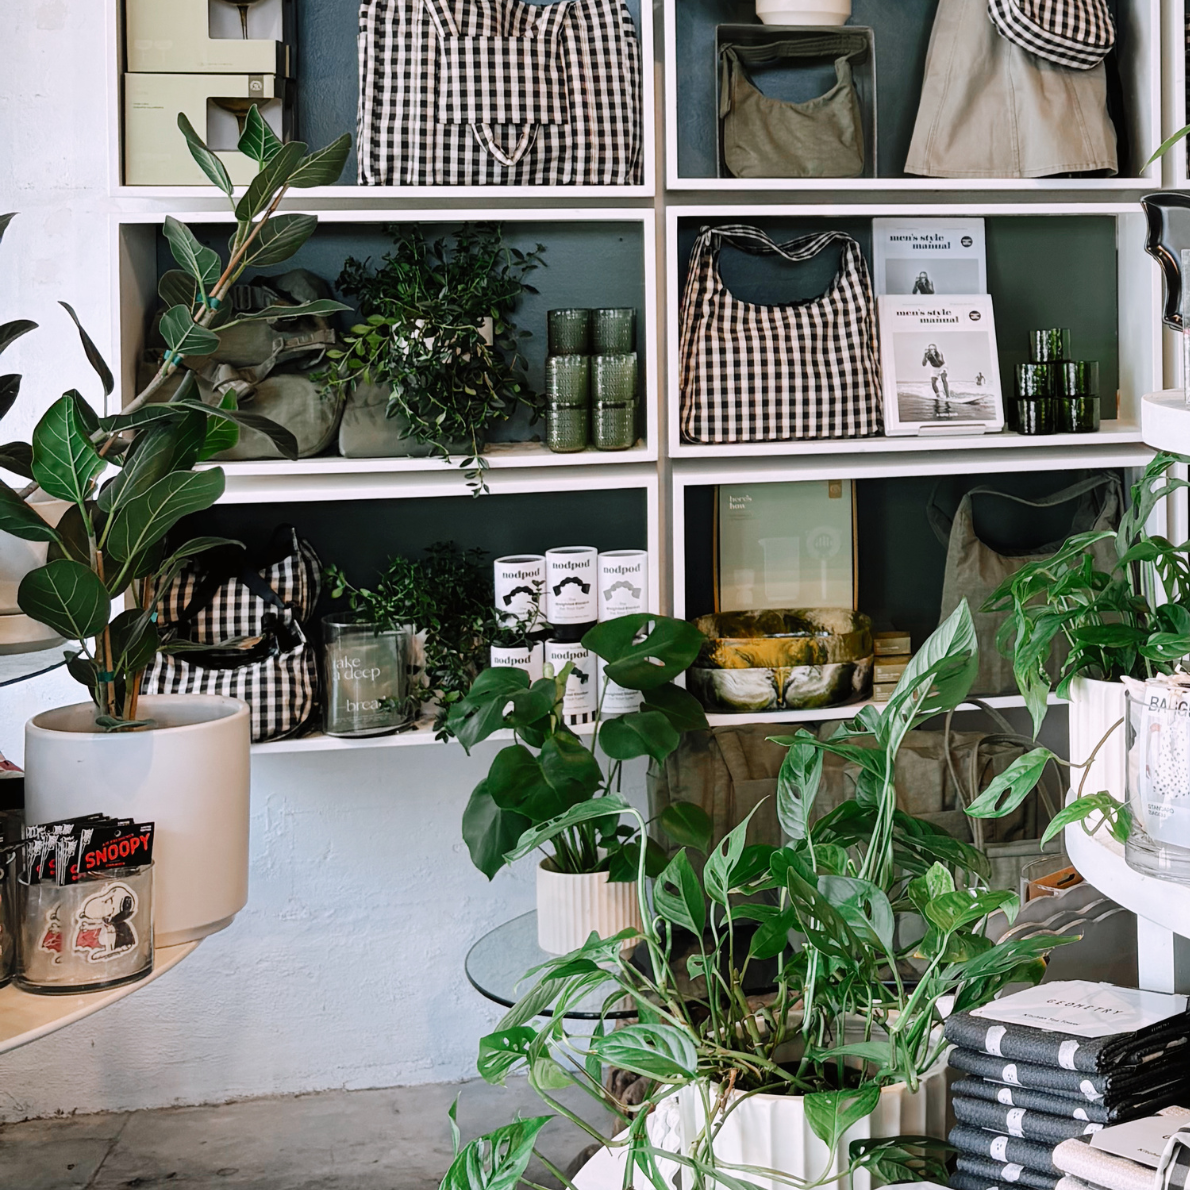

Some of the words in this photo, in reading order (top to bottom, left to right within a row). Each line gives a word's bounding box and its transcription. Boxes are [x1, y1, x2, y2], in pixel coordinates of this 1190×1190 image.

[890, 233, 918, 241] men's
[920, 233, 944, 243] style
[912, 241, 951, 249] manual
[927, 309, 952, 318] style
[552, 559, 590, 571] nodpod
[603, 563, 641, 575] nodpod
[502, 568, 540, 580] nodpod
[494, 655, 531, 666] nodpod
[551, 649, 589, 660] nodpod
[343, 666, 381, 681] deep
[85, 833, 150, 868] SNOOPY
[1046, 999, 1124, 1015] GEOMETRY
